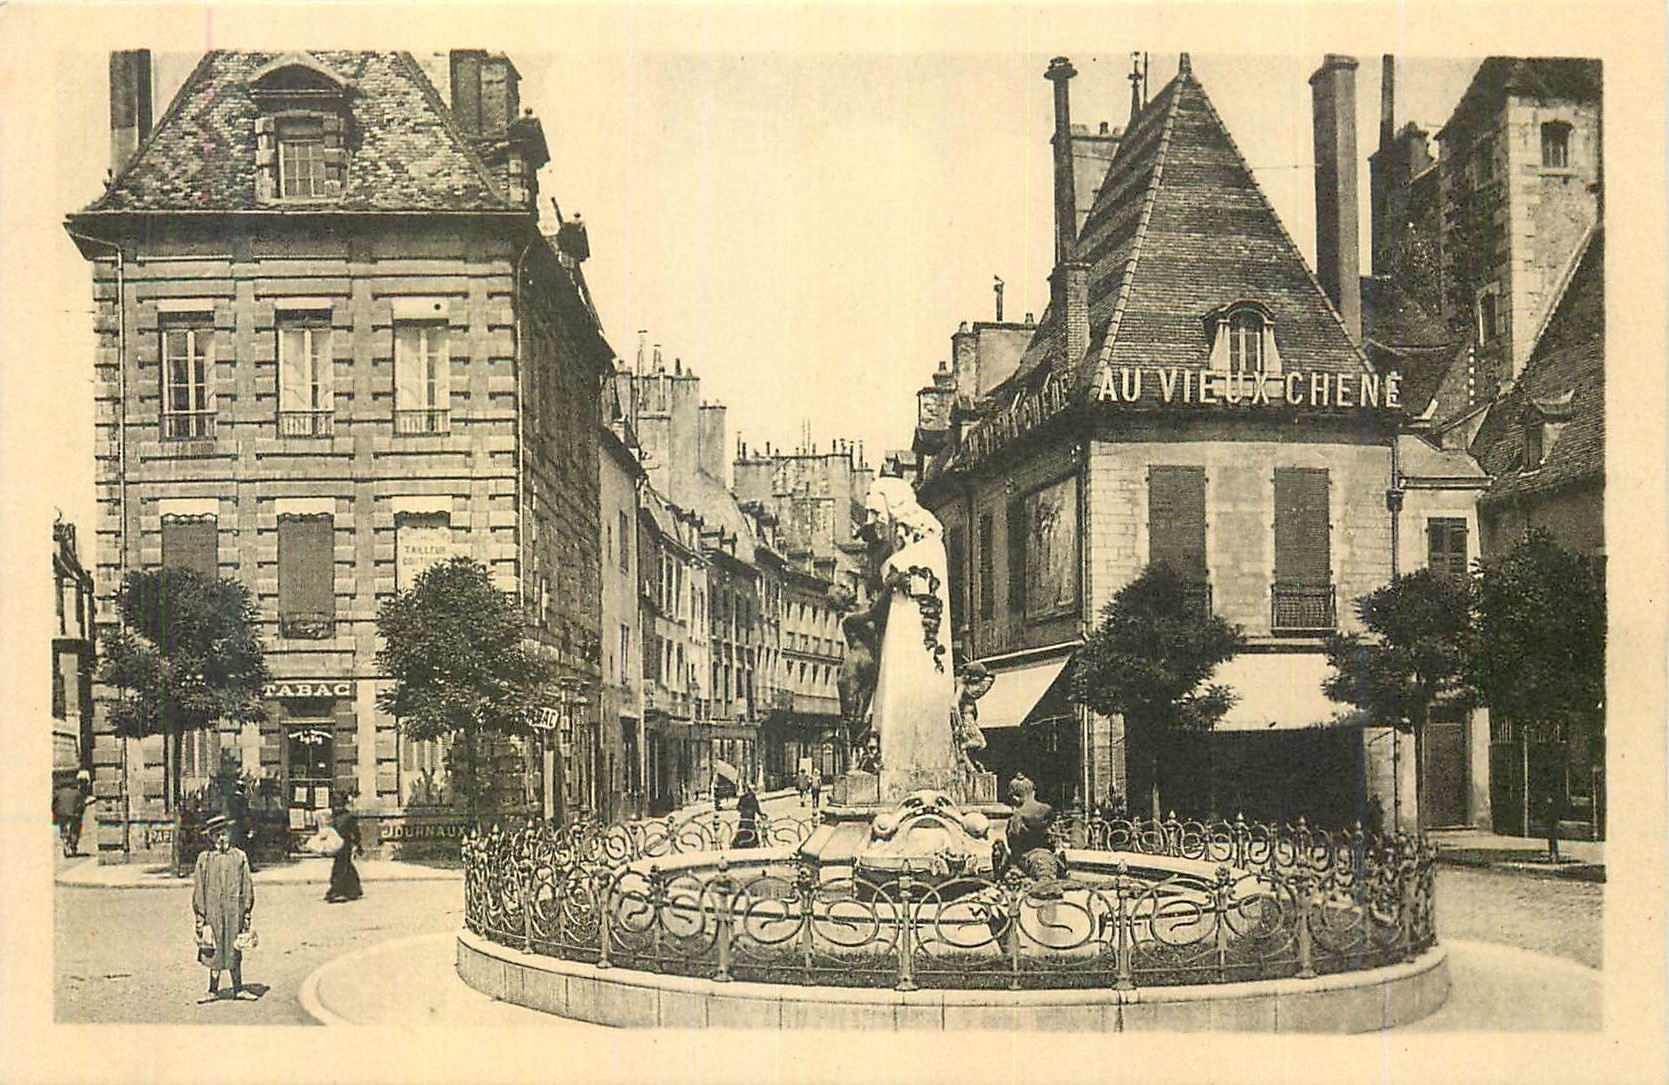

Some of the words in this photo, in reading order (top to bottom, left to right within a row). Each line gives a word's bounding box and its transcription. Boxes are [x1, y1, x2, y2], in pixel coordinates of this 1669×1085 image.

[1098, 367, 1141, 402] AU
[1159, 367, 1270, 404] VIEUX
[262, 684, 351, 697] TABAC
